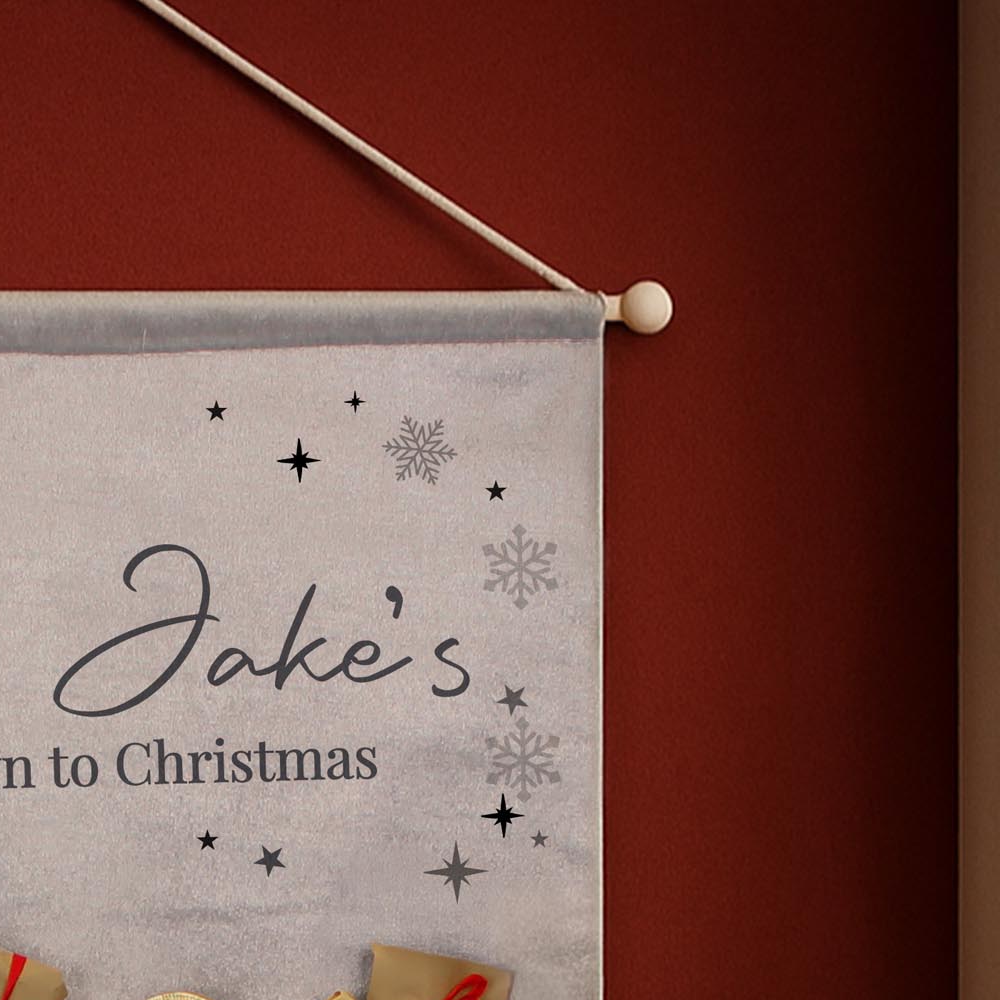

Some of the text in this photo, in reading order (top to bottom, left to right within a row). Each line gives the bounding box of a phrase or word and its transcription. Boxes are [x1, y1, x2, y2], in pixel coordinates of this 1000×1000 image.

[53, 543, 471, 718] Jake's
[48, 746, 99, 788] to
[117, 738, 380, 787] Christmas
